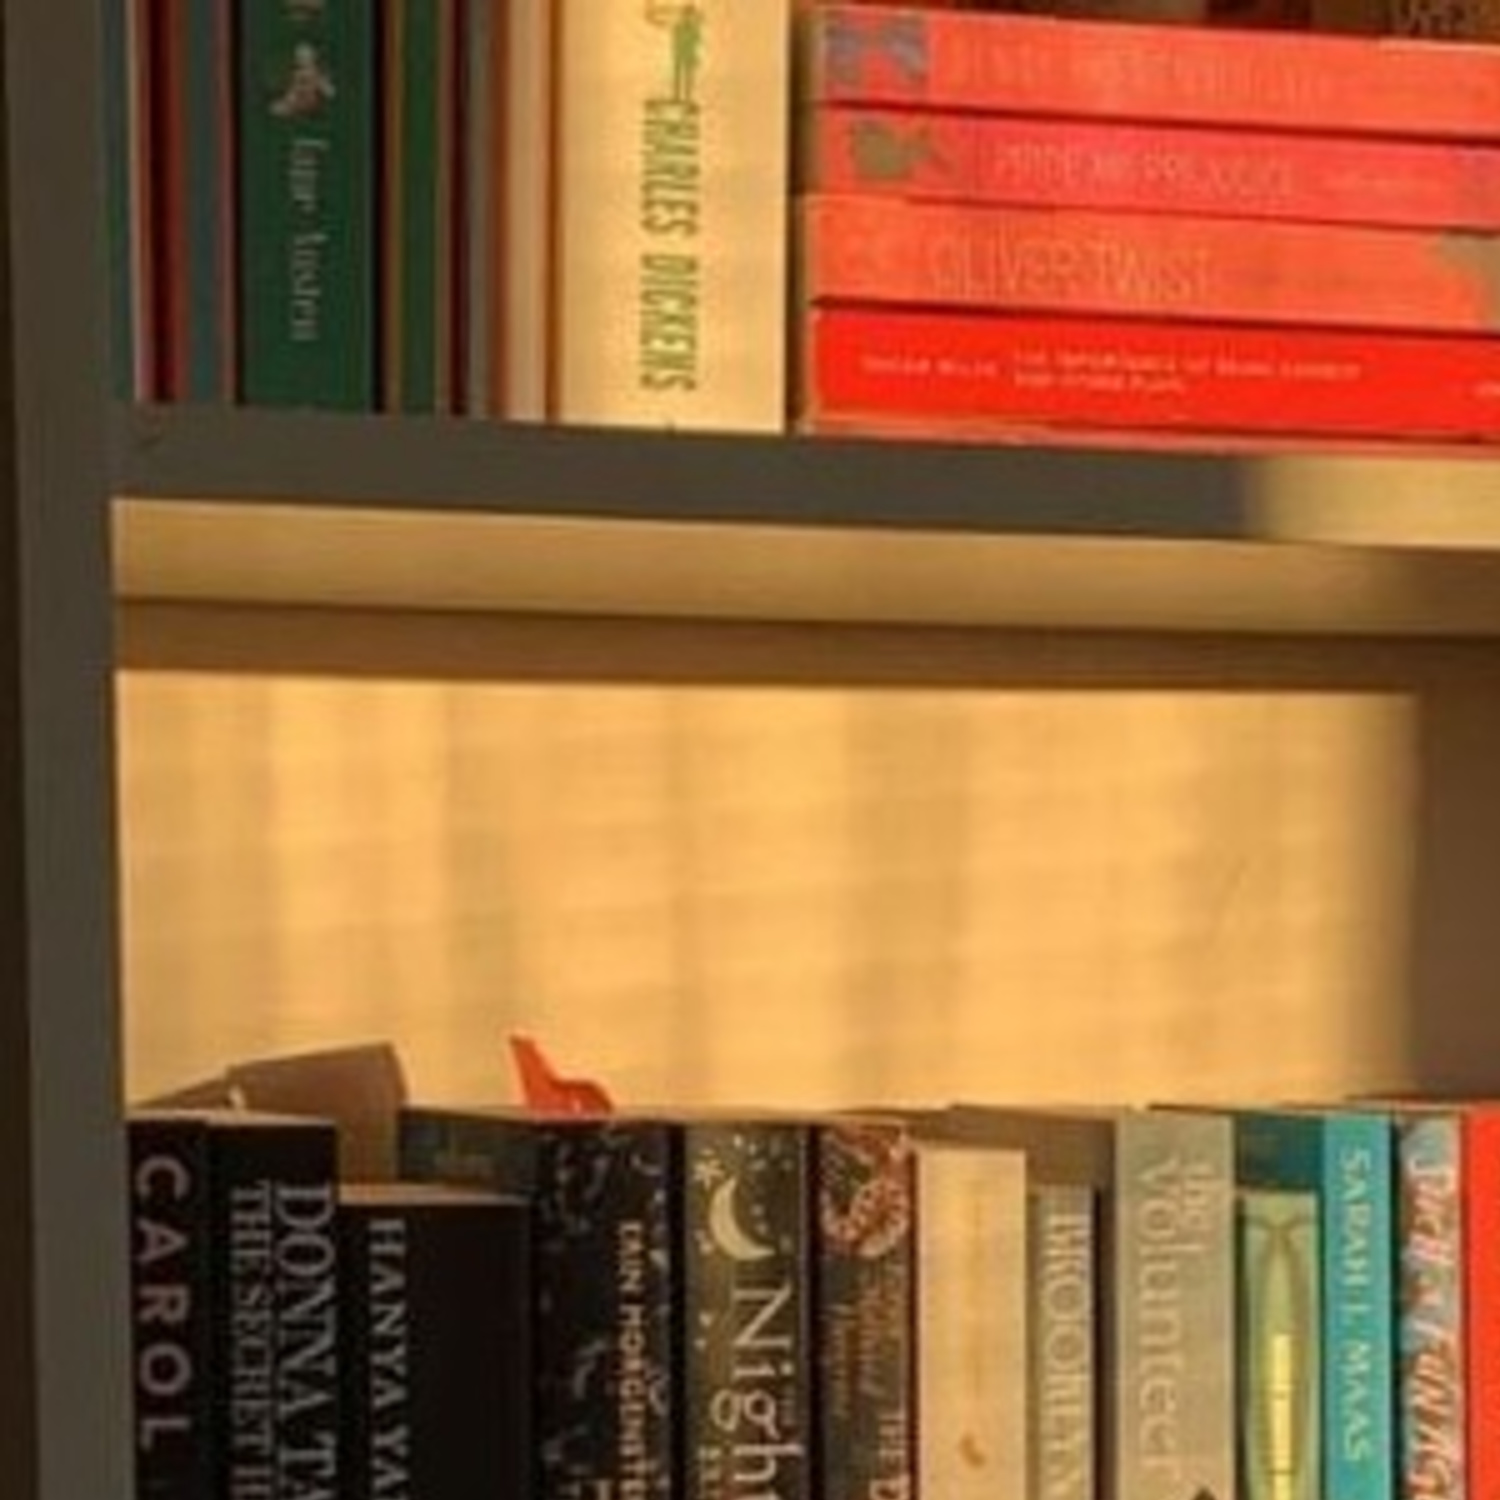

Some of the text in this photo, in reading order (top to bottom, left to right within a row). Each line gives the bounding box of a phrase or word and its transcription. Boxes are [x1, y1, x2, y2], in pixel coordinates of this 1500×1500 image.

[639, 98, 702, 393] CHARLES DICKENS
[134, 1152, 194, 1452] CAROL
[229, 1178, 275, 1273] THE
[274, 1182, 338, 1420] DONNA
[1338, 1146, 1373, 1288] SARAH
[229, 1281, 275, 1457] SECRET
[366, 1217, 411, 1409] HANYA
[1134, 1156, 1206, 1478] volunteer
[1341, 1332, 1373, 1462] MAAS
[874, 1408, 906, 1467] THE
